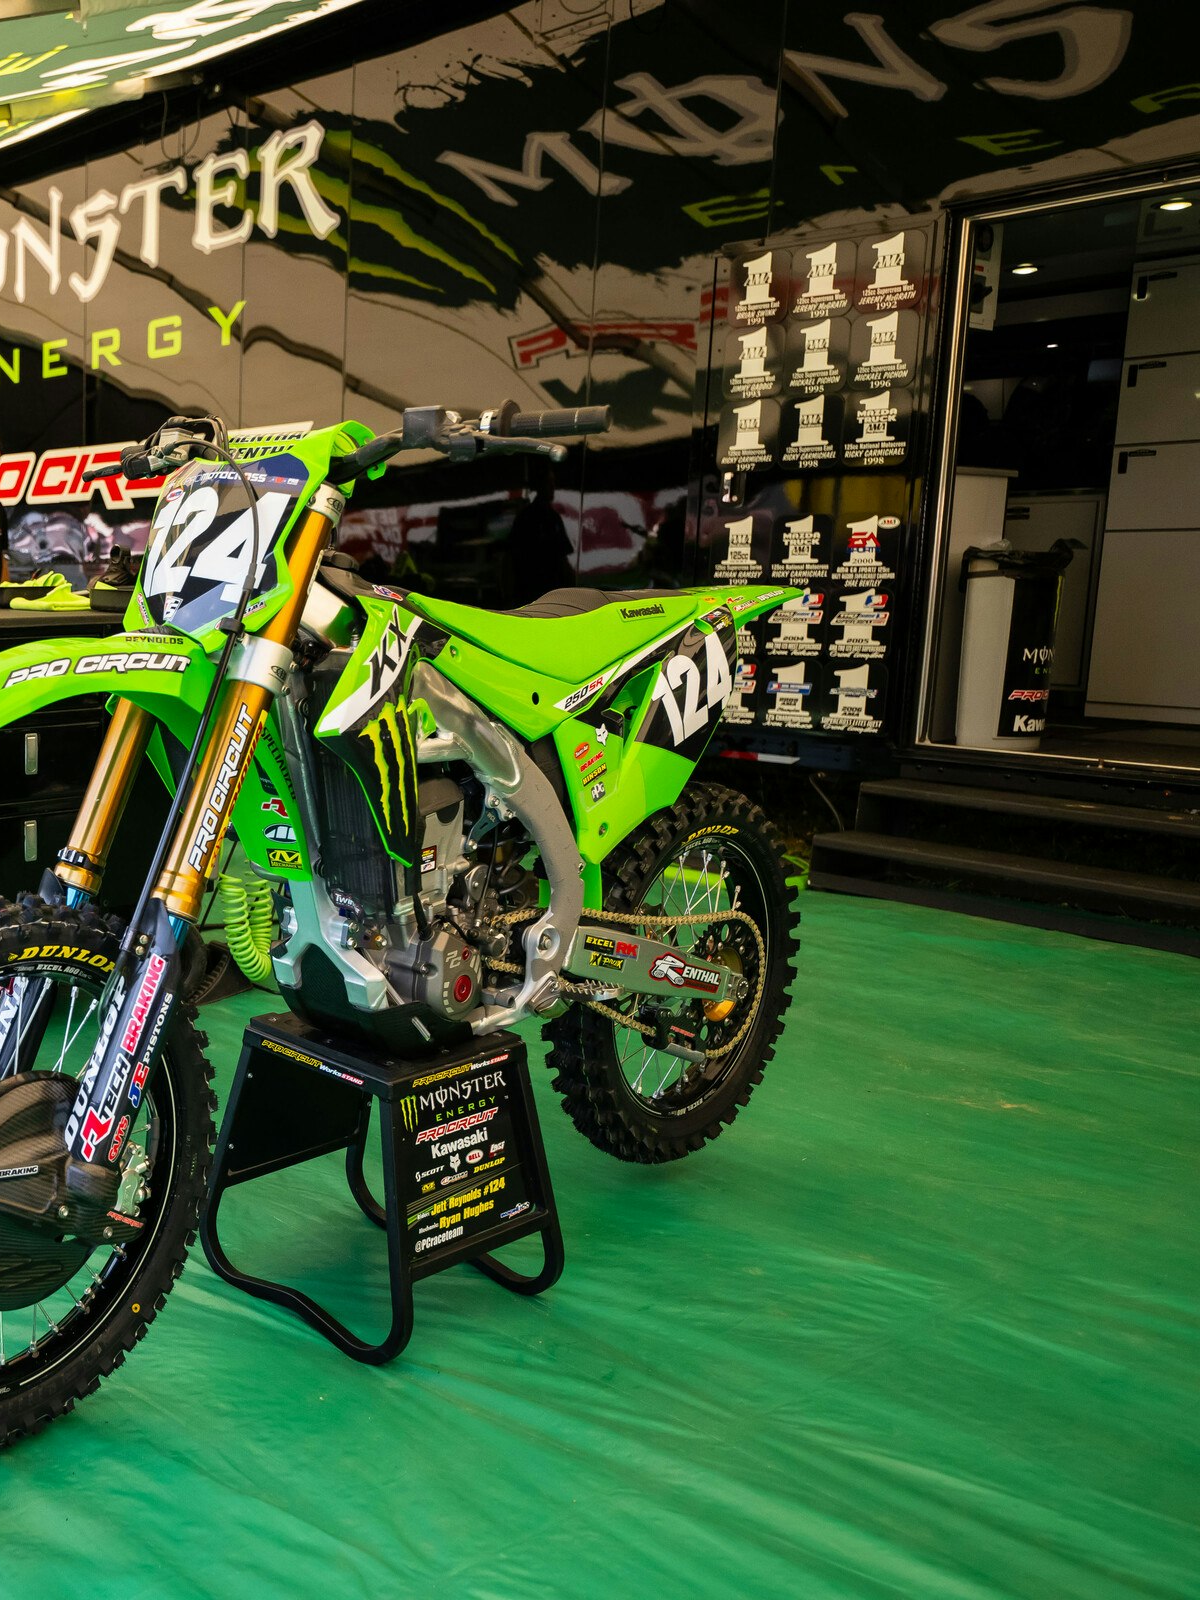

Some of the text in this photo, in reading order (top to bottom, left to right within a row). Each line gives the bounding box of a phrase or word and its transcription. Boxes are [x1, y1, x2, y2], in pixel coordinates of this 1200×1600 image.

[868, 232, 908, 289] 1
[872, 253, 905, 269] AMA
[802, 242, 840, 297] 1
[807, 263, 837, 278] AMA
[739, 251, 775, 305] 1
[745, 272, 772, 286] AMA
[858, 291, 916, 306] JEREMY McGRATH
[875, 301, 898, 311] 1992
[793, 299, 847, 314] JEREMY McGRATH
[747, 317, 765, 326] 1991
[809, 310, 829, 319] 1991
[805, 338, 829, 350] AMA
[861, 311, 902, 367] 1
[872, 331, 897, 344] AMA
[734, 326, 771, 378] 1
[739, 345, 767, 360] AMA
[796, 319, 835, 372] 1
[789, 375, 840, 387] MICKAEL PICHON
[854, 369, 909, 383] MICKAEL PICHON
[804, 385, 824, 393] 1995
[870, 379, 891, 389] 1996
[742, 390, 762, 399] 1993
[800, 413, 823, 425] AMA
[856, 390, 895, 443] 1
[857, 407, 898, 418] MAZDA
[857, 415, 898, 425] TRUCK
[729, 400, 765, 450] 1
[738, 418, 760, 430] AMA
[791, 394, 829, 447] 1
[866, 422, 887, 433] AMA
[721, 453, 772, 465] RICKY CARMICHAEL
[782, 449, 836, 461] RICKY CARMICHAEL
[844, 447, 905, 458] RICKY CARMICHAEL
[736, 462, 756, 471] 1997
[799, 459, 819, 468] 1998
[863, 456, 885, 466] 1998
[720, 515, 757, 565] 1
[782, 532, 820, 541] MAZDA
[782, 514, 819, 564] 1
[783, 538, 820, 546] TRUCK
[842, 514, 883, 566] 1
[143, 486, 291, 604] 124
[730, 550, 749, 560] 125cc
[713, 569, 763, 579] NATHAN RAMSEY
[771, 569, 788, 578] RICKY
[789, 570, 828, 578] CARMICHAEL
[728, 578, 748, 586] 1999
[789, 577, 809, 586] 1999
[858, 579, 882, 588] BENTLEY
[620, 603, 665, 620] Kawasaki
[835, 588, 880, 645] 1
[125, 636, 184, 645] REYNOLDS
[369, 603, 408, 700] KX
[2, 652, 191, 690] PRO CIRCUIT
[564, 676, 604, 709] 250 SR
[651, 631, 732, 747] 124
[768, 661, 810, 717] 1
[829, 664, 874, 720] 1
[580, 751, 604, 772] BRAKING
[582, 763, 607, 786] HINSON
[188, 808, 219, 872] PRO
[209, 702, 254, 814] CIRCUIT
[687, 824, 740, 843] DUNLOP
[585, 936, 614, 949] EXCEL
[615, 941, 639, 958] RK
[36, 964, 63, 972] EXCEL
[63, 966, 80, 975] A60
[120, 953, 166, 1056] BRAKING
[142, 992, 173, 1063] PISTONS
[419, 1071, 506, 1111] MONSTER
[436, 1096, 496, 1122] ENERGY
[415, 1106, 499, 1145] PRO CIRCUIT
[107, 1114, 131, 1163] GUTS
[430, 1127, 488, 1159] Kawasaki
[467, 1152, 482, 1162] BELL
[420, 1165, 445, 1178] SCOTT
[473, 1157, 505, 1173] DUNLOP
[431, 1201, 446, 1216] Jett
[448, 1188, 482, 1210] Reynolds
[483, 1177, 505, 1196] #124
[439, 1212, 461, 1229] Ryan
[463, 1199, 495, 1220] Hughes
[414, 1225, 464, 1253] @PCraceteam
